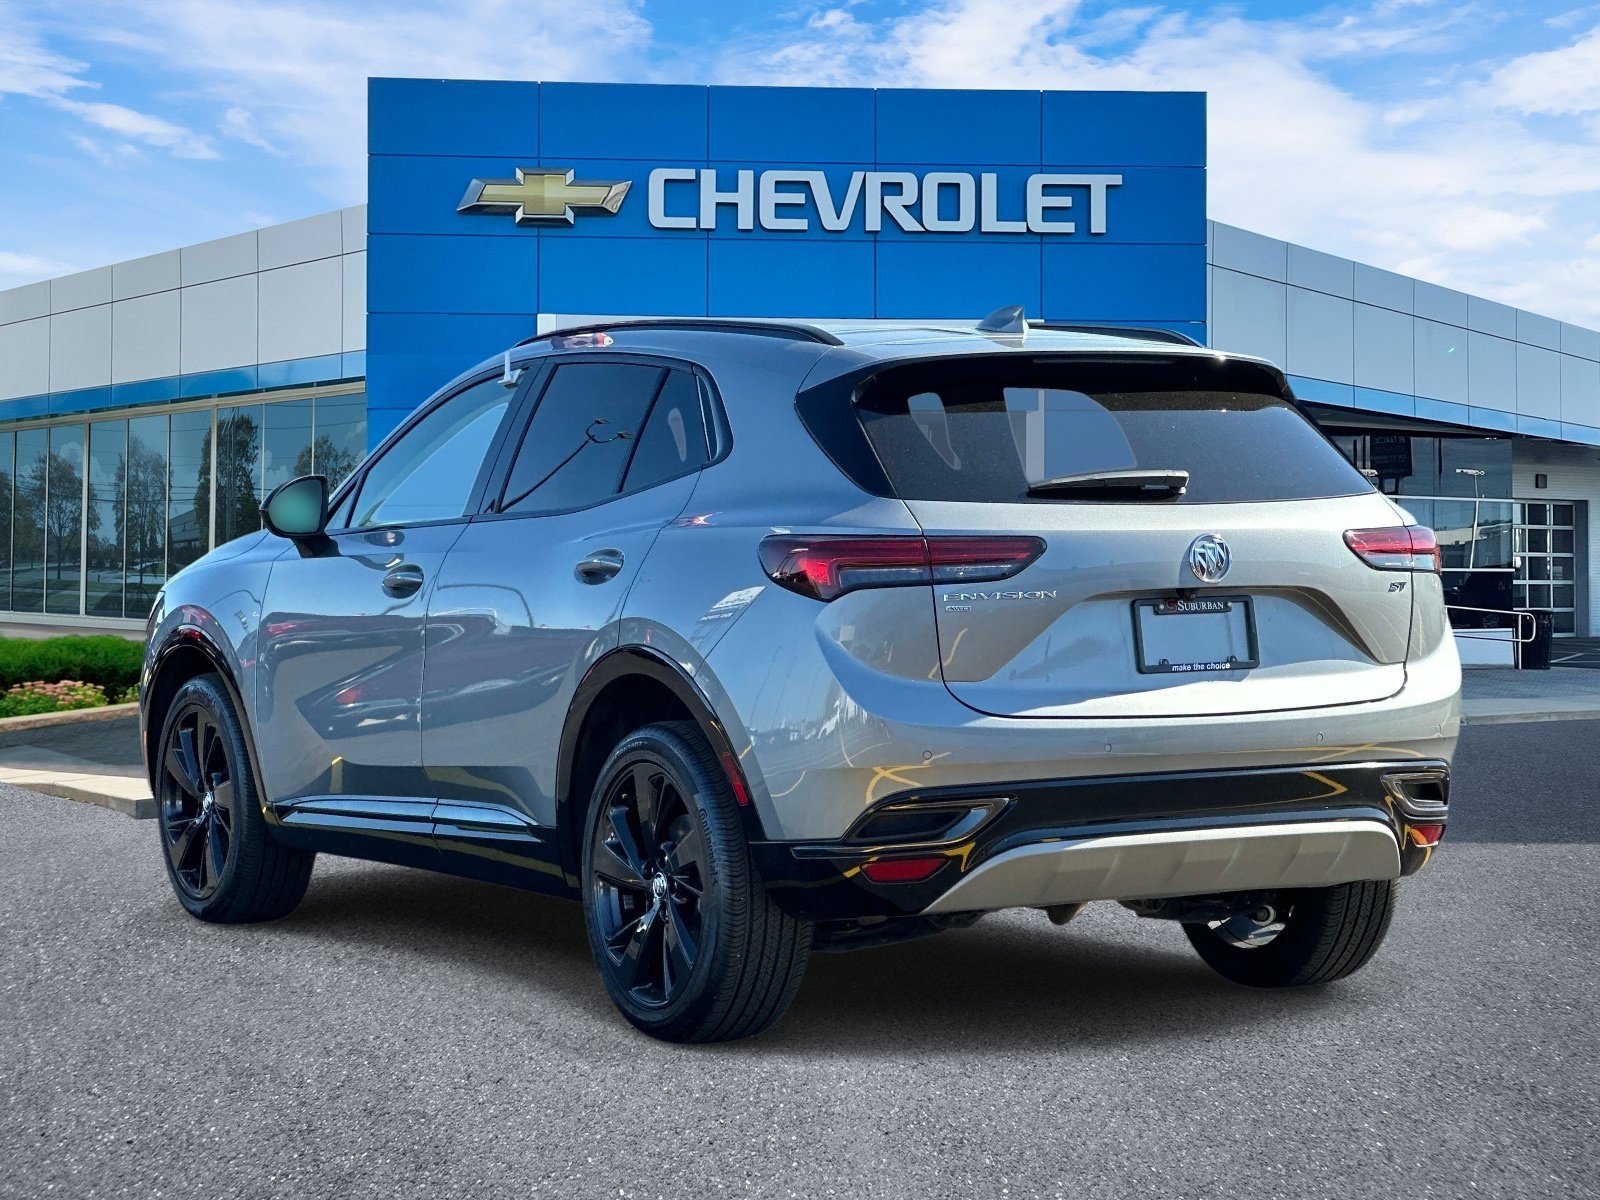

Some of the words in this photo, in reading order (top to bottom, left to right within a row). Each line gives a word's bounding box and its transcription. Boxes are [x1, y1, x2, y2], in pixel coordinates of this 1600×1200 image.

[648, 167, 1123, 234] CHEVROLET
[943, 590, 1057, 602] ENVISION
[1177, 599, 1224, 611] SUBURBAN
[1172, 664, 1192, 672] make
[1193, 663, 1205, 671] the
[1206, 661, 1231, 670] choice
